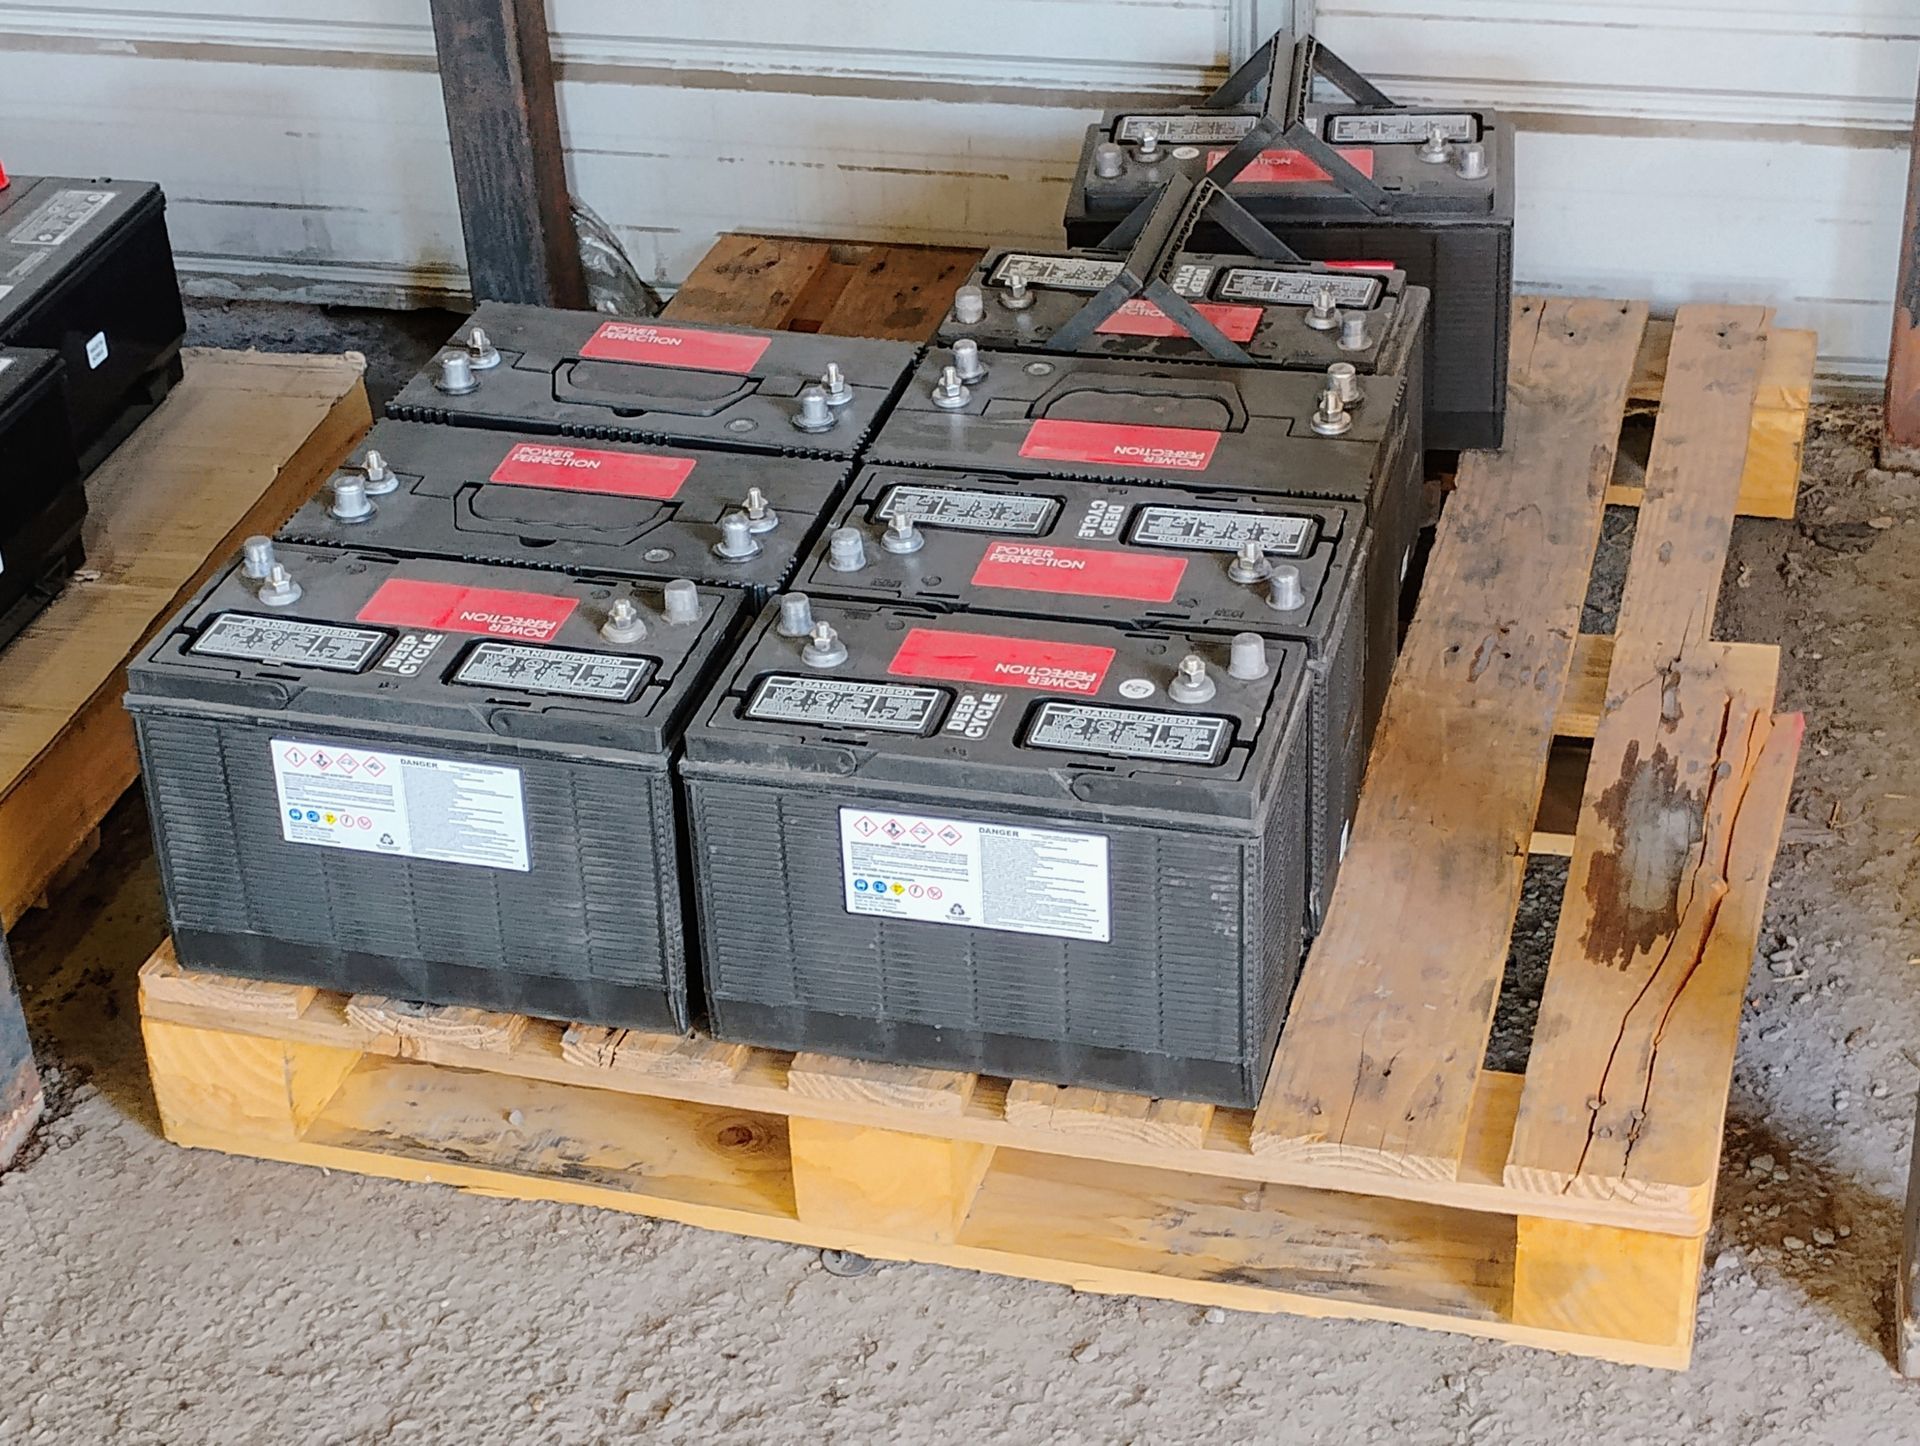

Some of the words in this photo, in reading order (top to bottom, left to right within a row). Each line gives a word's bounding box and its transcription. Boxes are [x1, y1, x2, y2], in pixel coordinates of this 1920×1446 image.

[1189, 268, 1211, 293] DEEP
[607, 325, 658, 336] POWER
[600, 331, 682, 346] PERFECTION
[519, 447, 575, 458] POWER
[1113, 446, 1205, 460] PERFECTION
[511, 455, 601, 469] PERFECTION
[1143, 456, 1201, 467] POWER
[1078, 500, 1108, 537] CYCLE
[1100, 505, 1125, 535] DEEP
[995, 545, 1054, 558] POWER
[989, 553, 1086, 570] PERFECTION
[460, 611, 557, 630] PERFECTION
[488, 623, 549, 638] POWER
[382, 635, 418, 668] DEEP
[398, 633, 443, 674] CYCLE
[995, 663, 1098, 682] PERFECTION
[802, 681, 915, 696] DANGER/POISON
[1027, 675, 1091, 690] POWER
[946, 694, 978, 731] DEEP
[964, 693, 1003, 738] CYCLE
[1081, 709, 1199, 725] DANGER/POISON
[400, 758, 438, 768] DANGER
[979, 827, 1019, 837] DANGER
